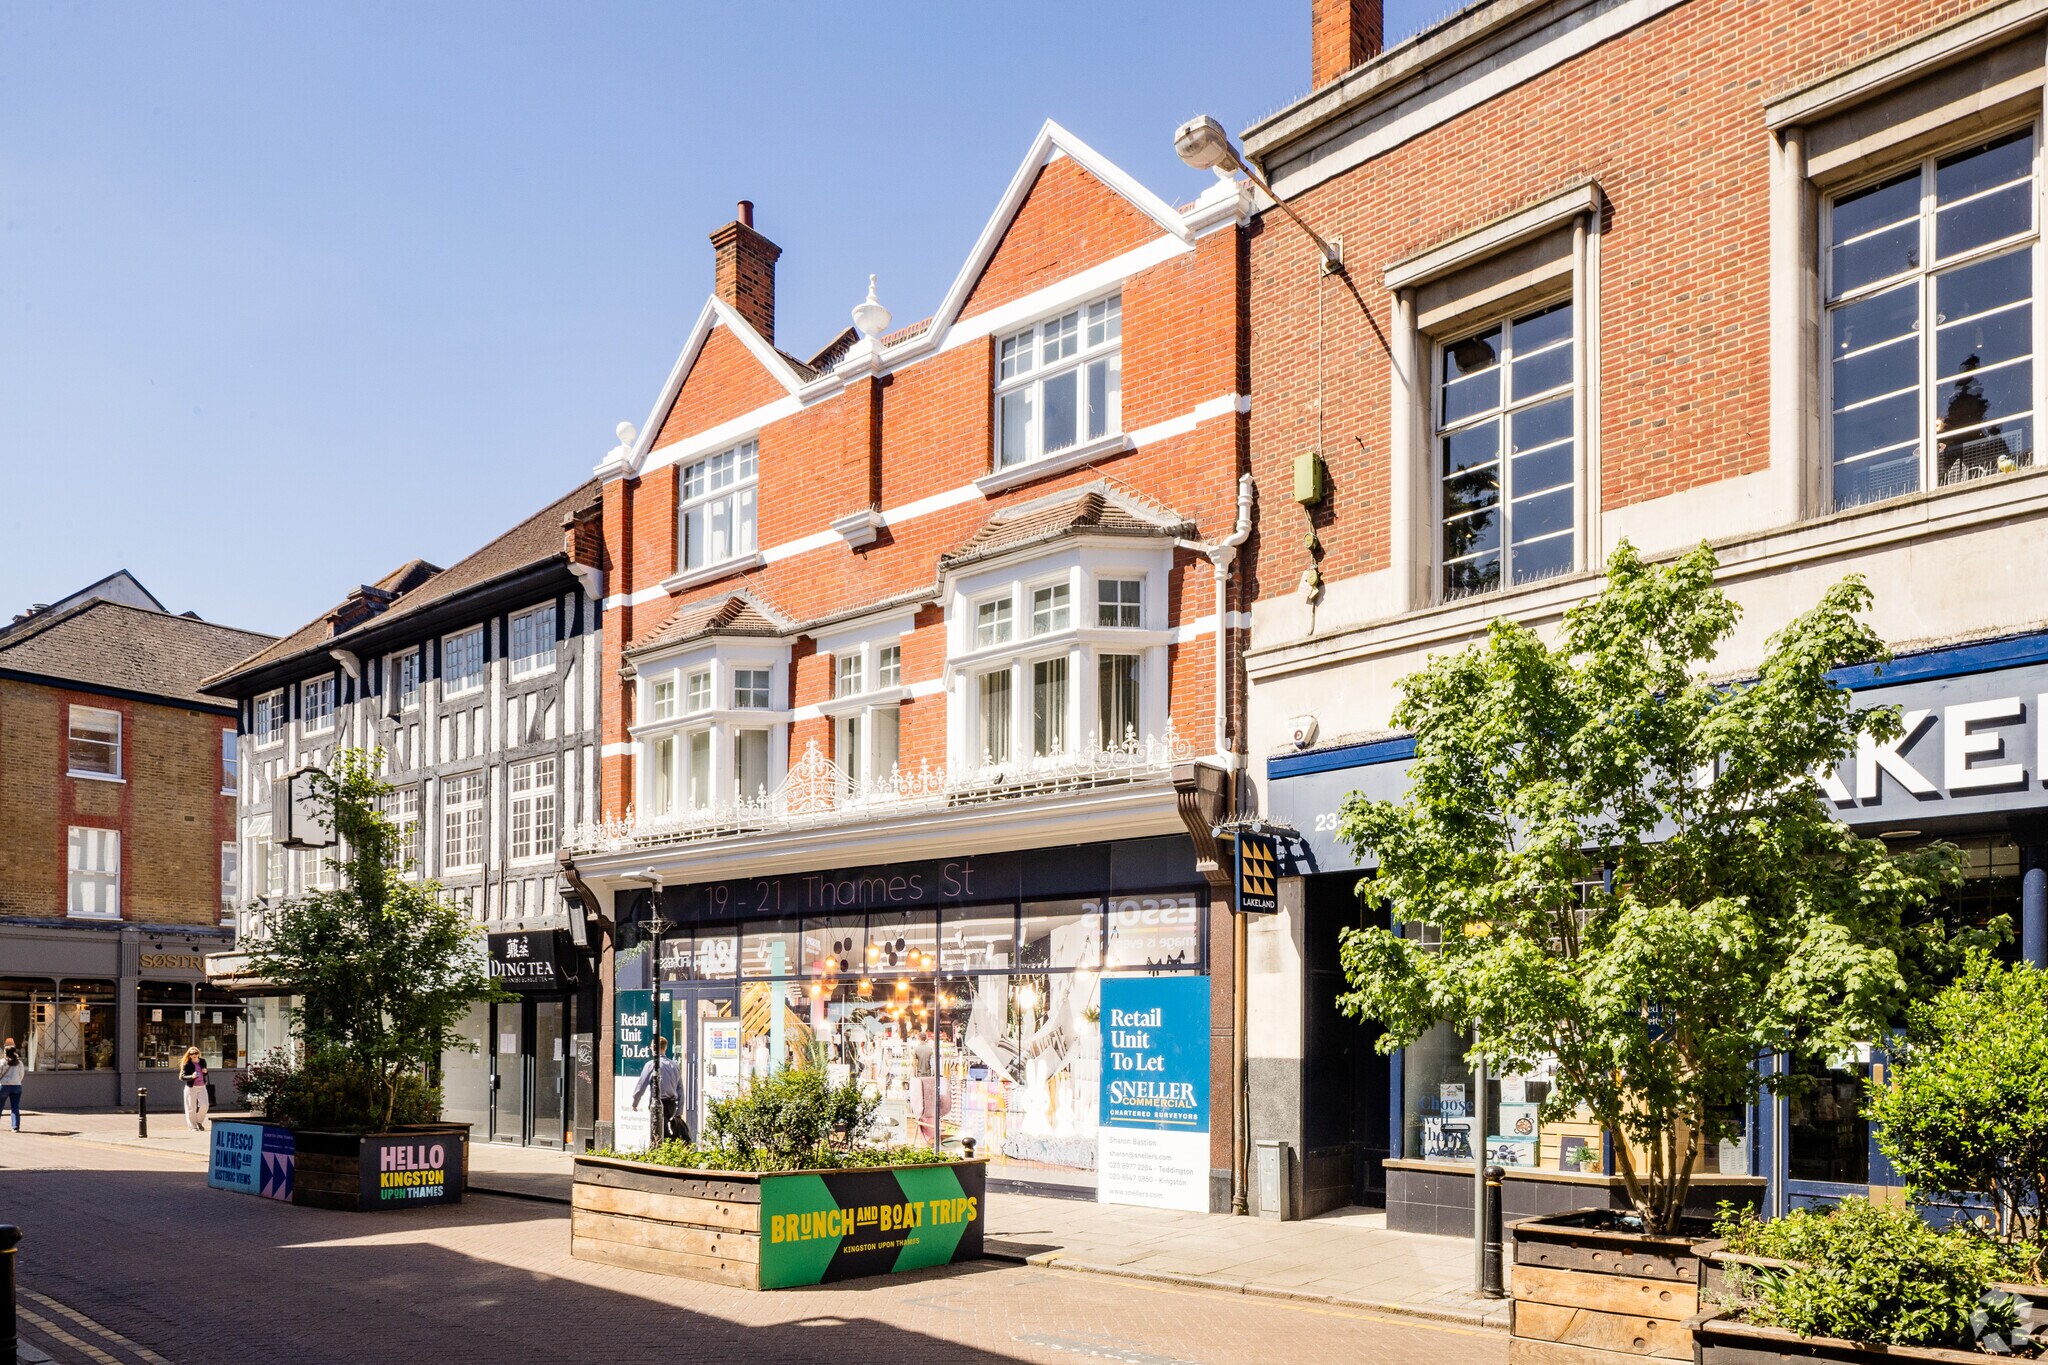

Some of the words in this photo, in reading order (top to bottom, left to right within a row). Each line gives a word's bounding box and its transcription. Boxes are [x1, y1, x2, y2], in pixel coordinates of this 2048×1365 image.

[705, 885, 728, 915] 19
[756, 880, 781, 912] 21
[802, 874, 924, 908] Thames
[944, 861, 974, 898] St
[1243, 897, 1275, 908] LAKELAND
[490, 960, 526, 977] DING
[527, 962, 554, 976] TEA
[621, 1012, 648, 1026] Retail
[1110, 1008, 1162, 1027] Retail
[621, 1028, 642, 1042] Unit
[1110, 1030, 1150, 1048] Unit
[620, 1044, 633, 1058] To
[634, 1044, 650, 1058] Let
[1110, 1052, 1133, 1070] To
[1136, 1052, 1165, 1071] Let
[1110, 1080, 1198, 1106] SNELLER
[1122, 1098, 1192, 1108] COMMERCIAL
[1420, 1094, 1474, 1112] Choose
[1154, 1110, 1198, 1120] SURVEYORS
[216, 1130, 224, 1148] AL
[226, 1132, 254, 1151] FRESCO
[1109, 1136, 1131, 1145] Sharon
[1132, 1138, 1156, 1146] Bastion
[216, 1149, 242, 1170] DINING
[242, 1154, 252, 1166] AND
[380, 1144, 444, 1172] HELLO
[1109, 1151, 1172, 1161] sharon@snellers.com
[214, 1169, 236, 1182] HISTORIC
[236, 1172, 252, 1185] VIEWS
[1138, 1164, 1152, 1172] 2204
[1159, 1166, 1194, 1176] Teddington
[380, 1170, 444, 1188] KINGSTON
[1159, 1178, 1187, 1186] Kingston
[380, 1188, 406, 1200] UPON
[406, 1186, 444, 1198] THAMES
[1109, 1188, 1163, 1198] www.snellers.com
[771, 1207, 854, 1244] BRUNCH
[856, 1205, 878, 1226] AND
[880, 1202, 924, 1232] BOAT
[930, 1196, 978, 1226] TRIPS
[843, 1243, 876, 1254] KINGSTON
[878, 1241, 894, 1250] UPON
[896, 1237, 920, 1247] THAMES
